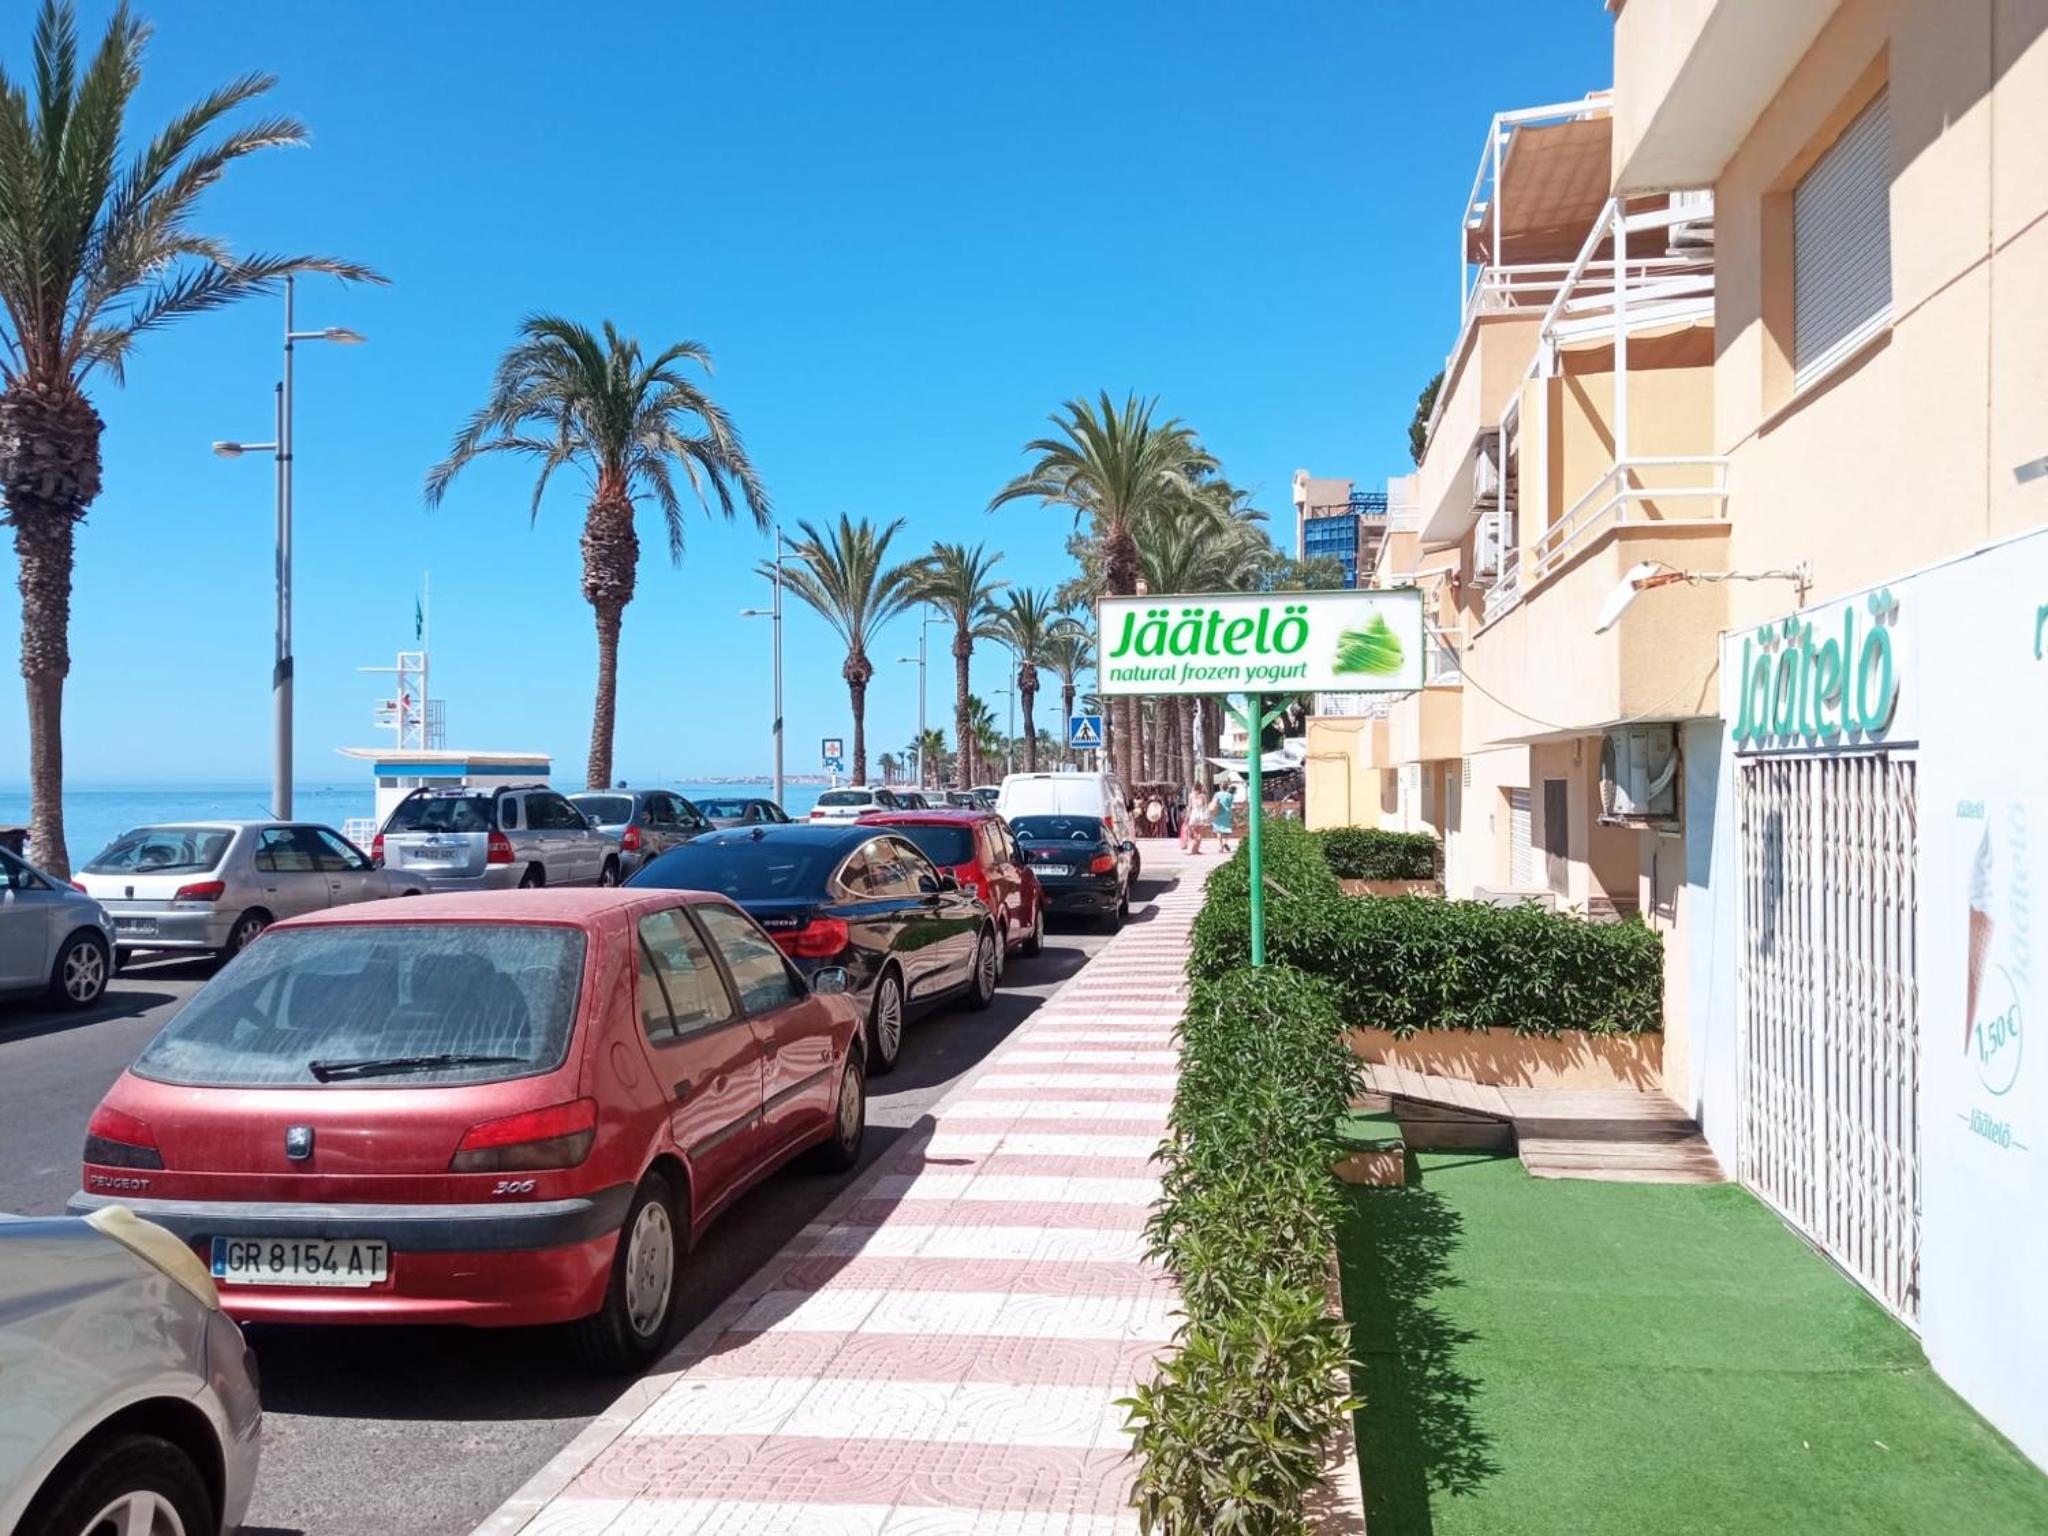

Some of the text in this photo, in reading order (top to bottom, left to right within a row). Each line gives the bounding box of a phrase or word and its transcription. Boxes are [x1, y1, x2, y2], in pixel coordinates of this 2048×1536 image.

[1109, 605, 1310, 658] Jäätelö
[1109, 661, 1307, 685] natural frozen yogurt
[1732, 587, 1896, 741] Jäätelö
[1975, 1003, 2018, 1065] 1,50€
[1968, 1107, 2012, 1150] Jäätelö
[89, 1175, 150, 1190] PEUGEOT
[491, 1179, 536, 1194] 306
[228, 1242, 383, 1276] GR 8154 AT
